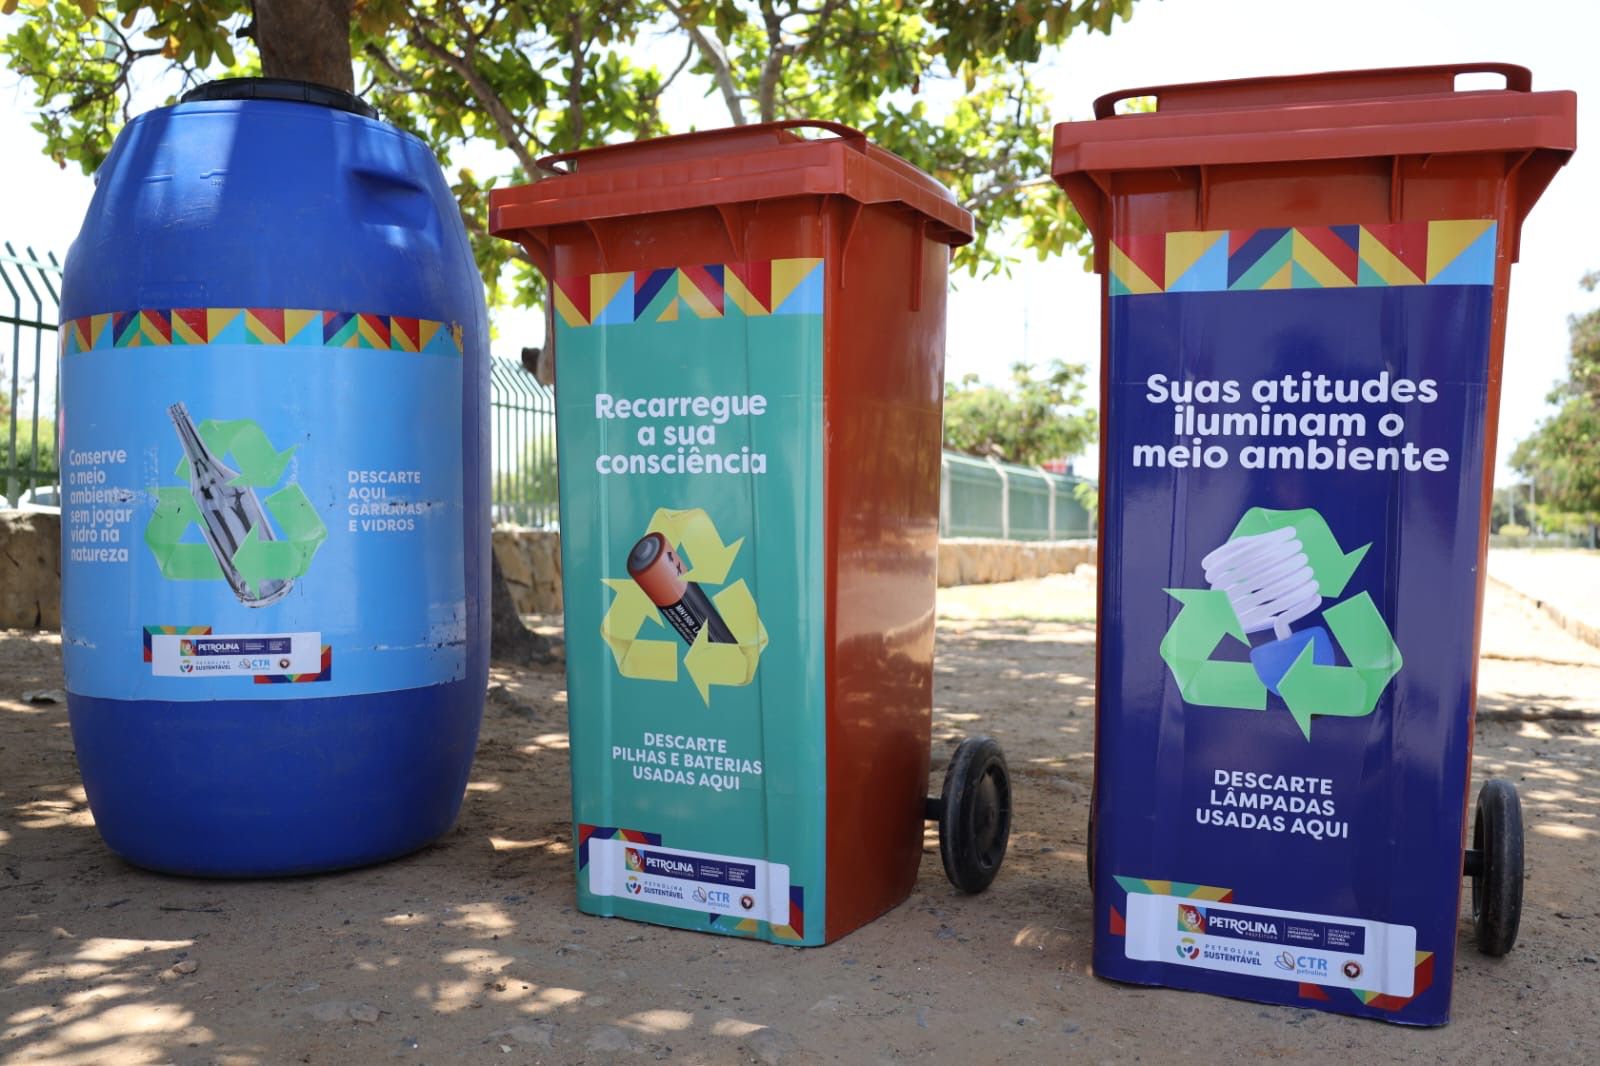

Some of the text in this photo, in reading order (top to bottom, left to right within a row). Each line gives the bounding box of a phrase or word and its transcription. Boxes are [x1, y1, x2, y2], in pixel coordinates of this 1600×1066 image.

[1146, 371, 1439, 403] Suas atitudes
[595, 394, 767, 424] Recarregue
[1174, 404, 1405, 437] iluminam o
[637, 424, 716, 446] a sua
[69, 449, 127, 465] Conserve
[595, 446, 767, 475] consciência
[1133, 438, 1450, 472] meio ambiente
[70, 466, 106, 485] o meio
[348, 470, 421, 484] DESCARTE
[348, 487, 386, 503] AQUI
[70, 505, 133, 528] sem jogar
[348, 519, 415, 532] E VIDROS
[71, 525, 120, 543] vidro na
[71, 546, 129, 562] natureza
[198, 643, 240, 653] PETROLINA
[644, 732, 727, 754] DESCARTE
[612, 746, 762, 775] PILHAS E BATERIAS
[633, 765, 740, 792] USADAS AQUI
[1214, 769, 1333, 795] DESCARTE
[1210, 787, 1335, 816] LÂMPADAS
[1196, 808, 1348, 840] USADAS AQUI
[646, 857, 694, 874] PETROLINA
[643, 886, 683, 900] SUSTENTÁVEL
[708, 890, 730, 903] CTR
[1209, 916, 1278, 935] PETROLINA
[1203, 950, 1262, 966] SUSTENTÁVEL
[1297, 956, 1327, 970] CTR
